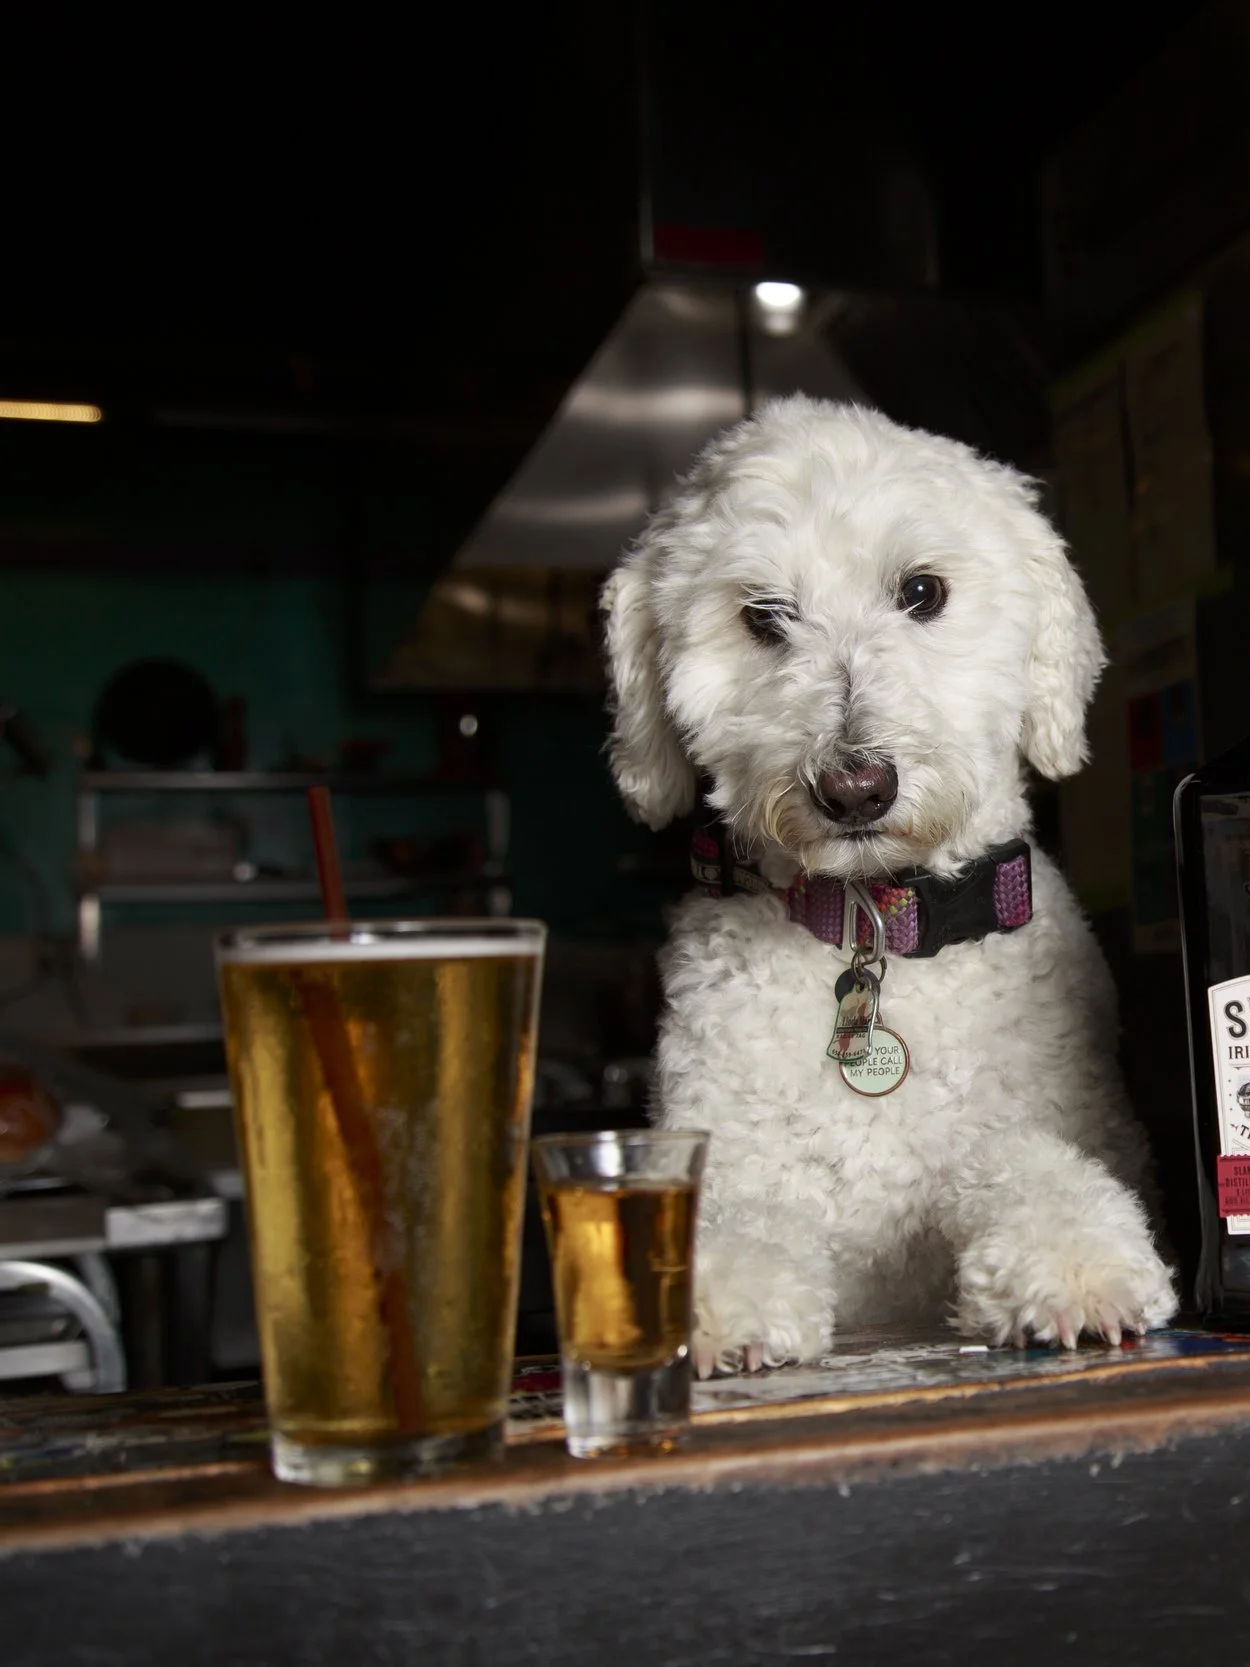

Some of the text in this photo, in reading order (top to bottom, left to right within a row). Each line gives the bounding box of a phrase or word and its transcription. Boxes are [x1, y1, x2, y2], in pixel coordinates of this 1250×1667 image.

[874, 1046, 899, 1055] YOUR
[880, 1056, 903, 1065] CALL
[850, 1067, 900, 1077] MY PEOPLE
